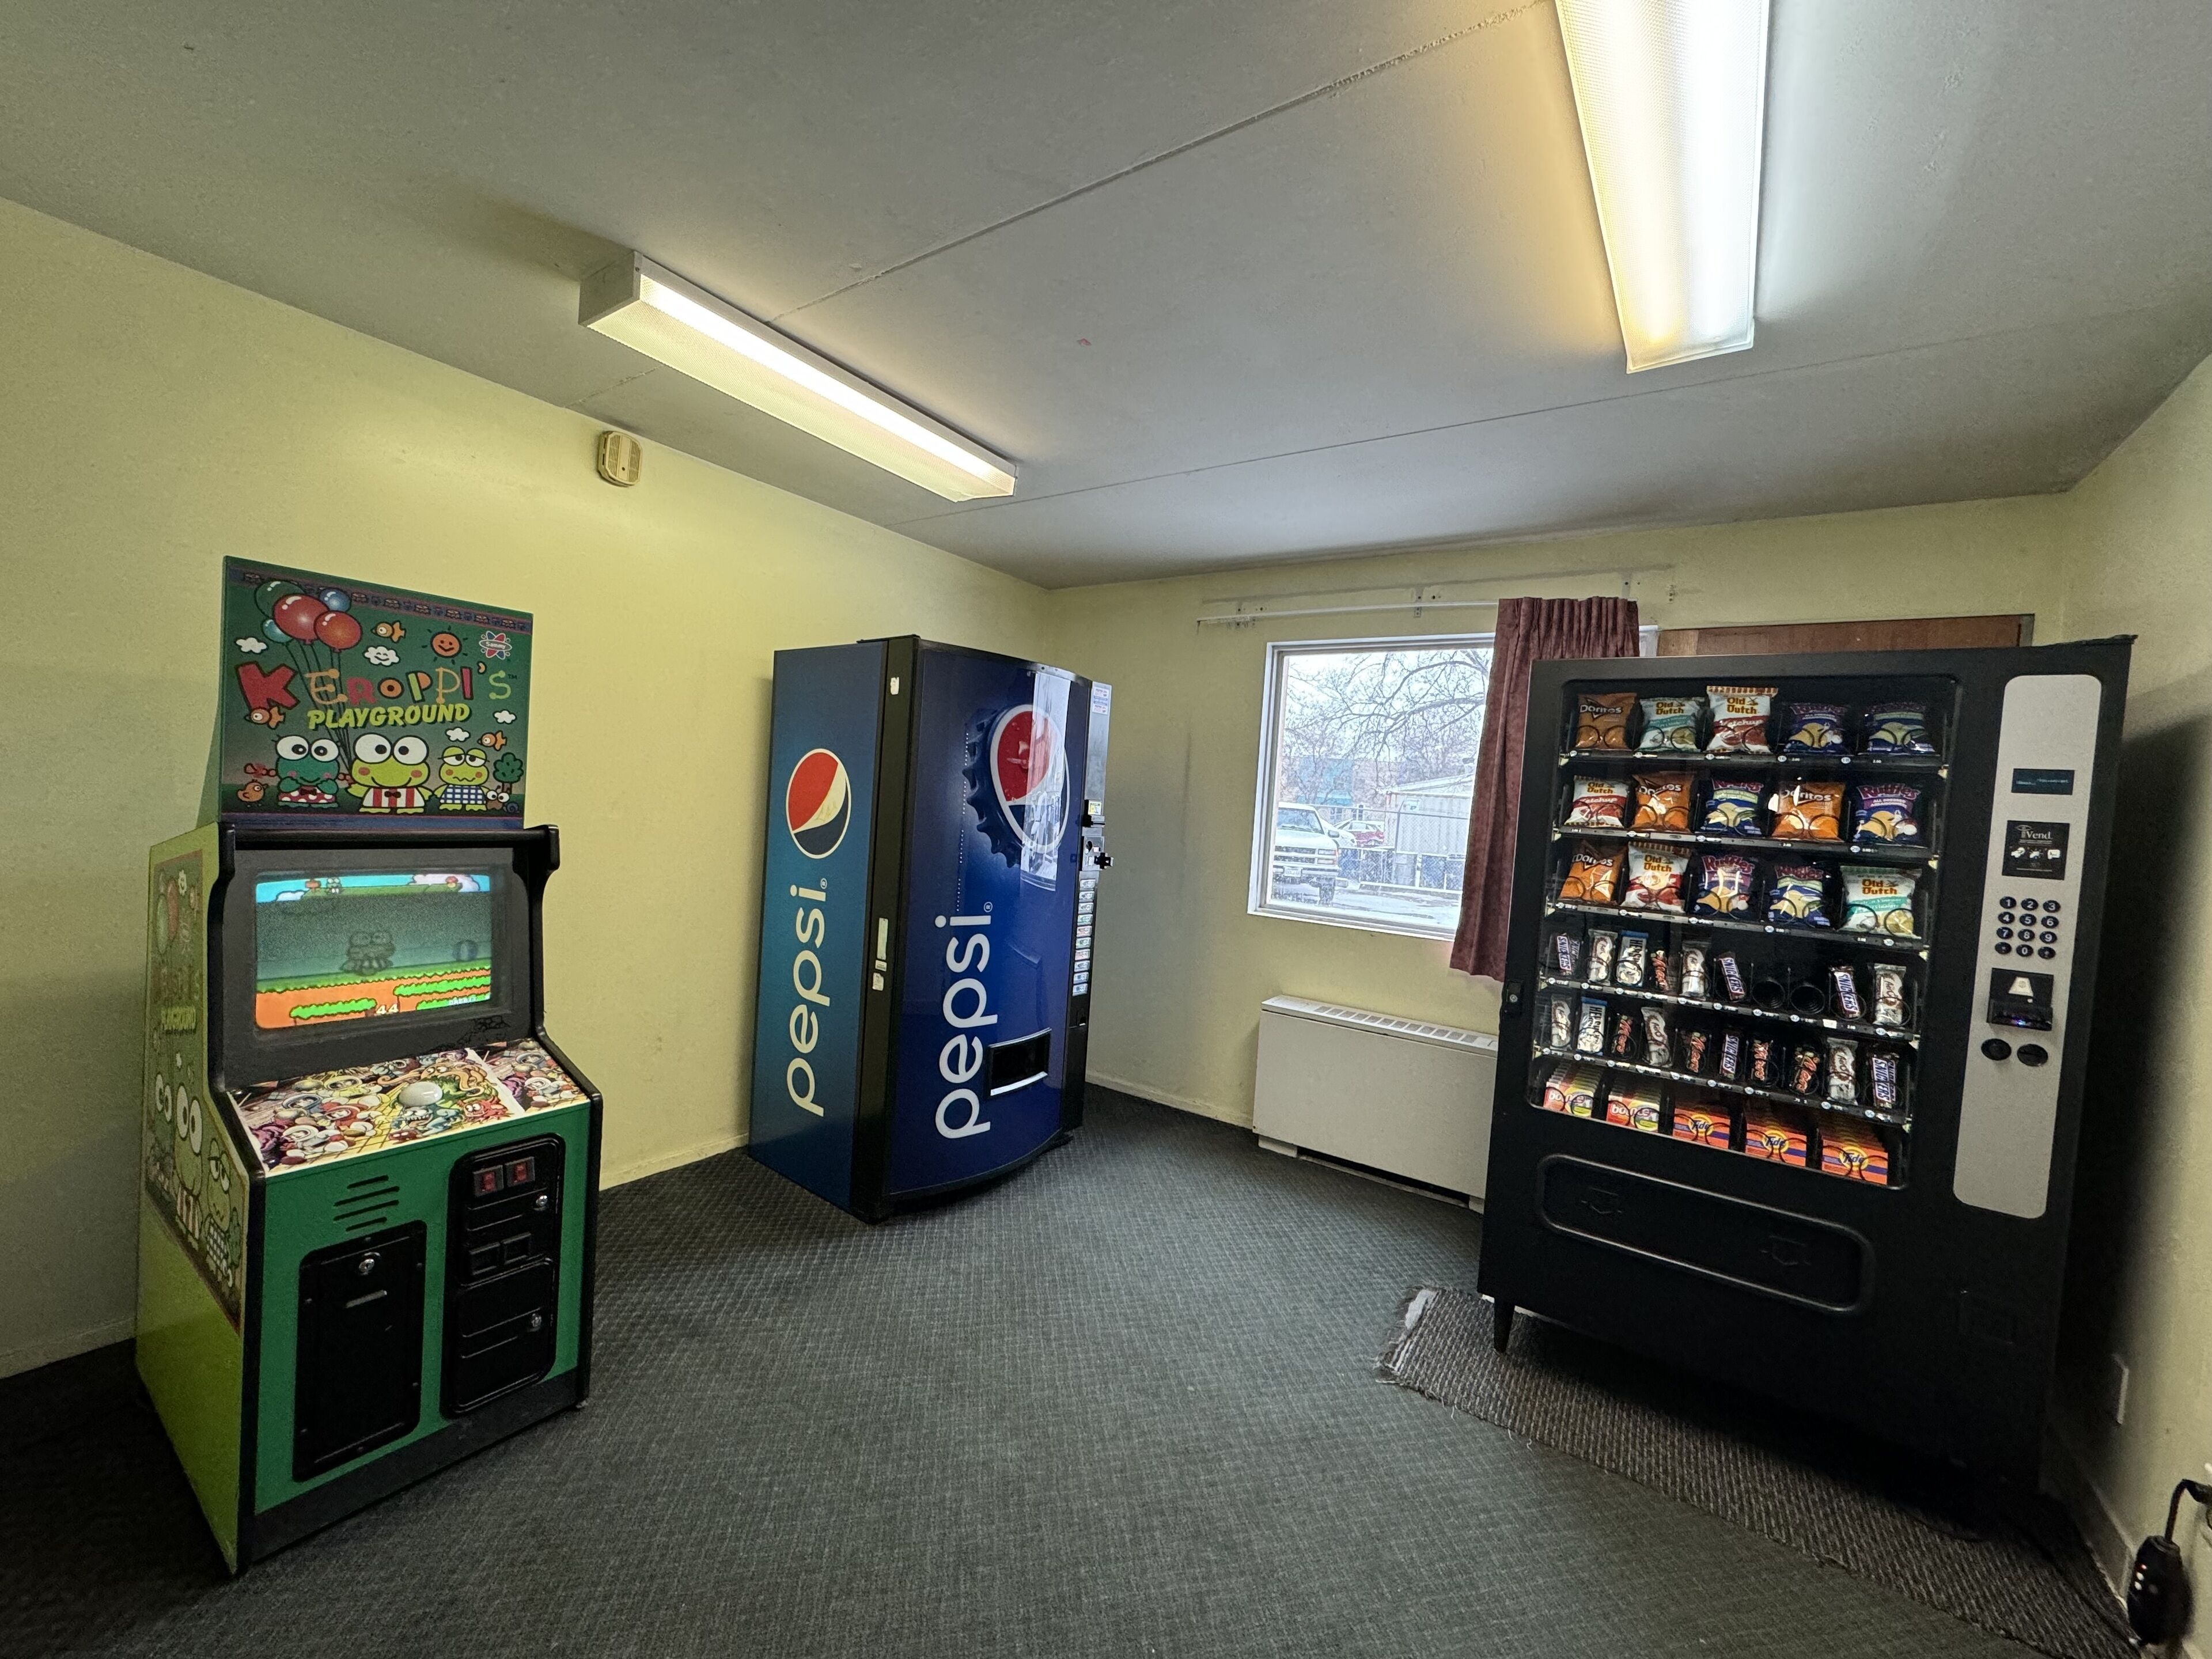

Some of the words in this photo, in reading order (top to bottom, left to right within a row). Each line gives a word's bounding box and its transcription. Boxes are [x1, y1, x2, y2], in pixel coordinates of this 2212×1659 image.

[486, 641, 506, 650] Sammy
[1728, 697, 1745, 705] Old
[1580, 704, 1622, 714] Doritos
[1727, 704, 1758, 714] Dutch
[306, 703, 470, 730] PLAYGROUND
[1857, 783, 1921, 800] Ruffles
[1645, 855, 1661, 863] Old
[1701, 855, 1755, 874] Ruffles
[1643, 862, 1672, 872] Dutch
[1862, 879, 1884, 887] Old
[1862, 887, 1897, 895] Dutch
[1558, 936, 1570, 969] SNICKERS
[1724, 957, 1743, 993] SNICKERS
[1839, 974, 1858, 1011] SNICKERS
[786, 884, 830, 1117] pepsi
[935, 915, 998, 1139] pepsi
[1724, 1036, 1738, 1073] SNICKERS
[1874, 1059, 1891, 1101] SNICKERS
[1691, 1120, 1710, 1131] Tide
[1766, 1136, 1786, 1147] Tide
[1843, 1152, 1865, 1164] Tide
